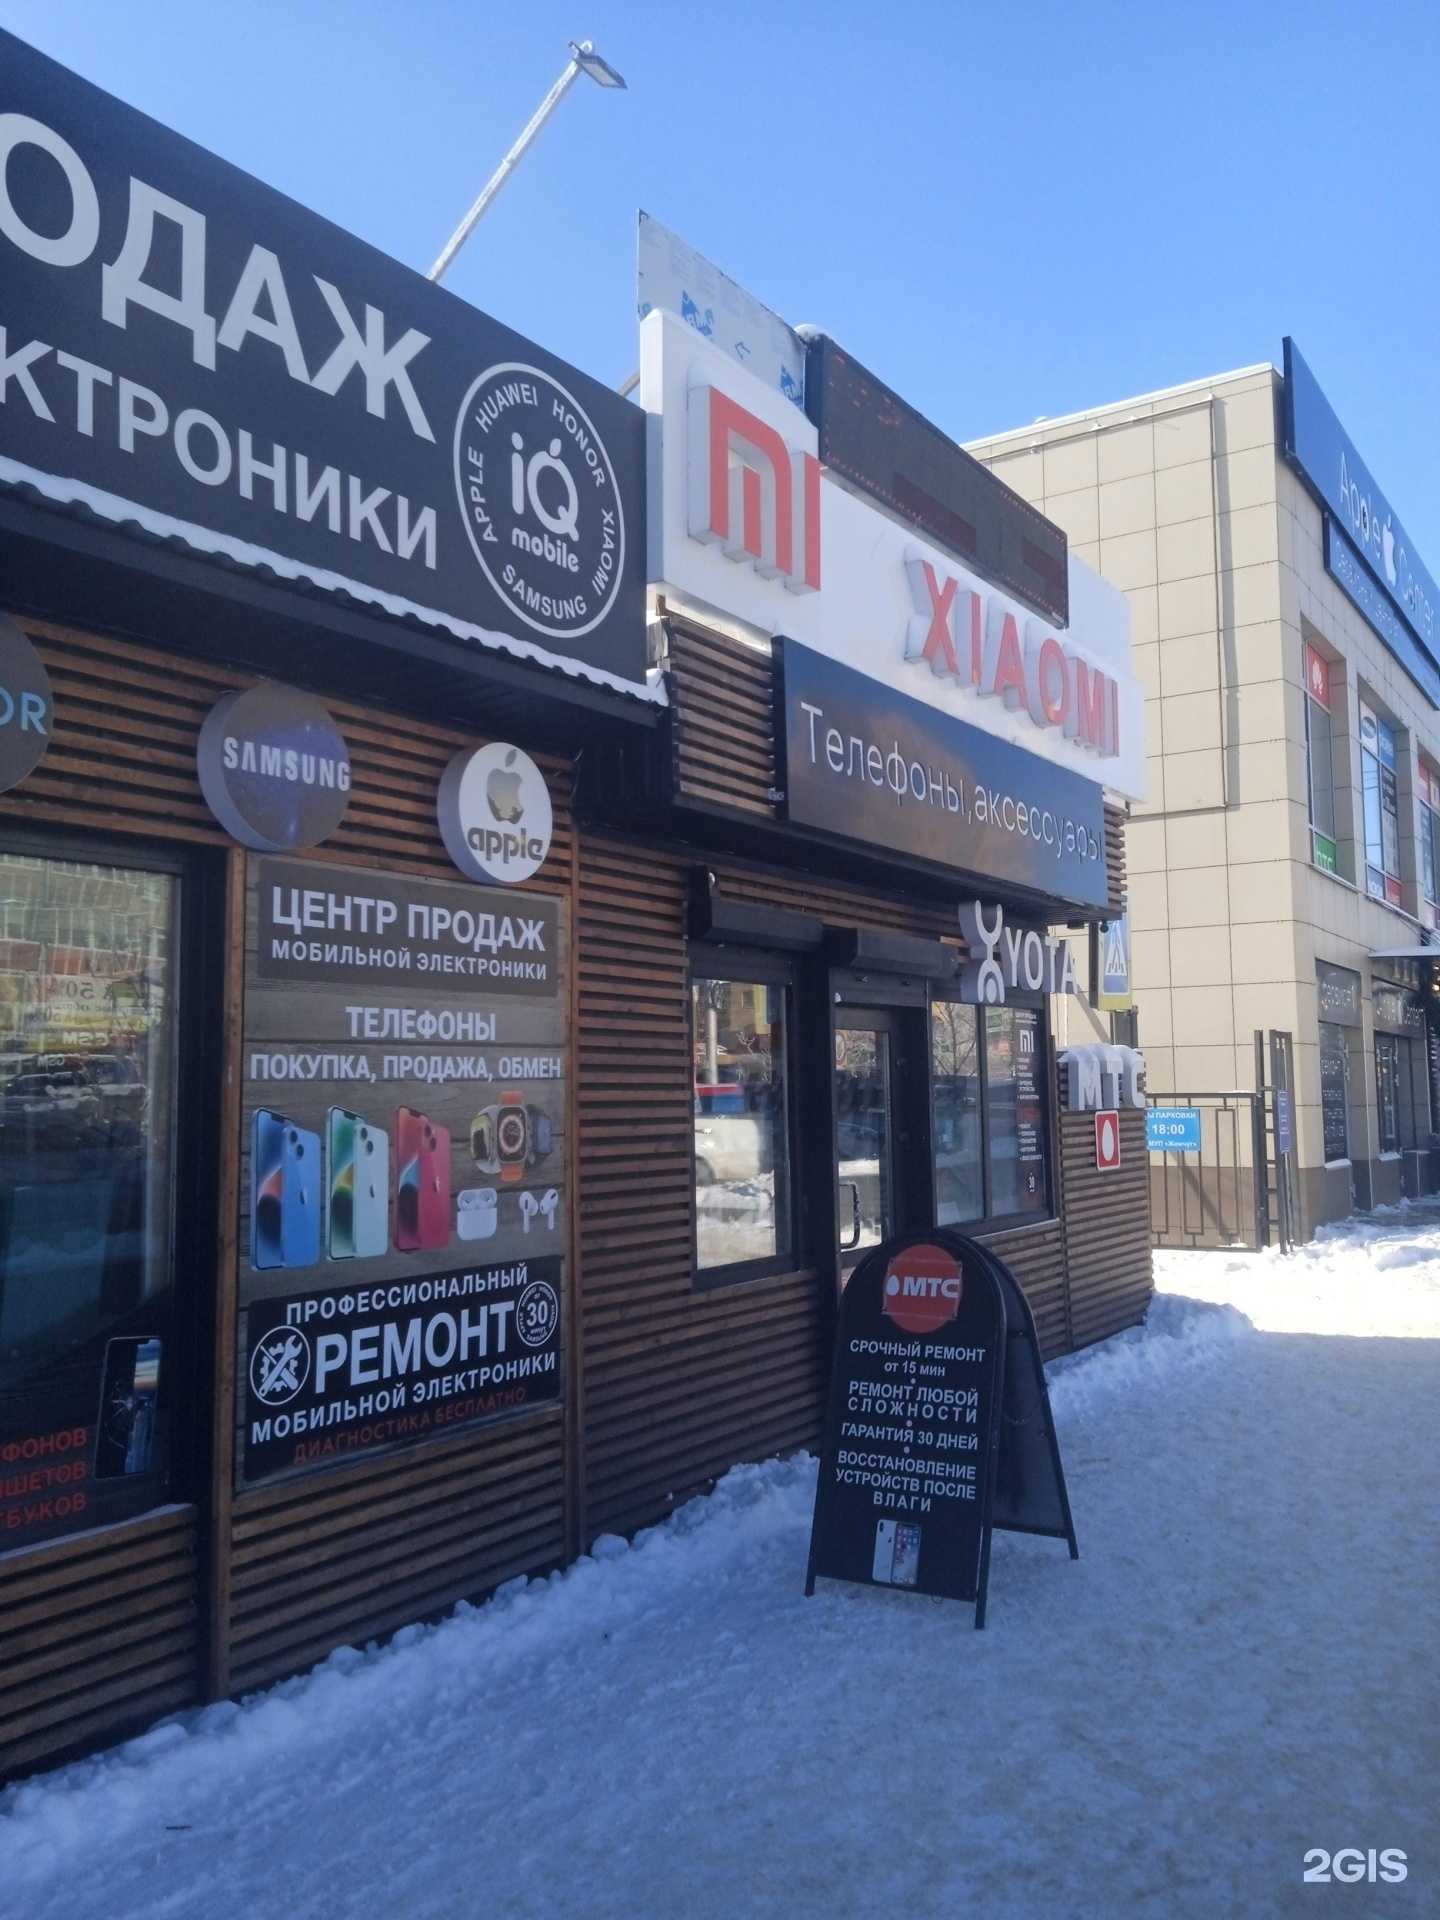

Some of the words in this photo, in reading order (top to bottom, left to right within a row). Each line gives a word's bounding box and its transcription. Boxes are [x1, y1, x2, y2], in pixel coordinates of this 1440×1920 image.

[0, 112, 437, 443] ОДАЖ
[0, 325, 437, 570] КТРОНИКИ
[475, 382, 539, 434] HUAWEI
[553, 398, 606, 487] HONOR
[468, 446, 498, 543] APPLE
[511, 431, 580, 541] iQ
[511, 527, 580, 573] mobile
[592, 508, 615, 595] XIAOMI
[502, 564, 587, 620] SAMSUNG
[918, 560, 1119, 757] XIAOMI
[223, 737, 351, 792] SAMSUNG
[466, 828, 544, 864] apple
[272, 886, 397, 935] ЦЕНТР
[408, 904, 546, 953] ПРОДАЖ
[271, 939, 411, 969] МОБИЛЬНОЙ
[416, 952, 547, 981] ЭЛЕКТРОНИКИ
[1004, 926, 1078, 994] YOTA
[346, 1006, 496, 1041] ТЕЛЕФОНЫ
[250, 1054, 377, 1083] ПОКУПКА,
[383, 1055, 494, 1084] ПРОДАЖА,
[499, 1057, 561, 1079] ОБМЕН
[1068, 1050, 1146, 1111] МТС
[1152, 1124, 1185, 1135] 18:00
[286, 1261, 528, 1326] ПРОФЕССИОНАЛЬНЫЙ
[902, 1276, 960, 1298] МТС
[526, 1300, 548, 1327] 30
[315, 1301, 515, 1394] РЕМОНТ
[850, 1339, 921, 1358] СРОЧНЫЙ
[924, 1345, 986, 1362] РЕМОНТ
[884, 1362, 898, 1373] от
[902, 1361, 916, 1374] 15
[919, 1366, 946, 1377] мин
[252, 1383, 405, 1444] МОБИЛЬНОЙ
[412, 1352, 556, 1403] ЭЛЕКТРОНИКИ
[848, 1381, 913, 1400] РЕМОНТ
[916, 1387, 979, 1407] ЛЮБОЙ
[848, 1397, 978, 1424] СЛОЖНОСТИ
[294, 1413, 432, 1465] ДИАГНОСТИКА
[434, 1386, 526, 1424] БЕСПЛАТНО
[841, 1422, 914, 1443] ГАРАНТИЯ
[917, 1431, 934, 1445] 30
[936, 1433, 979, 1451] ДНЕЙ
[0, 1460, 88, 1498] ШЕТОВ
[835, 1468, 920, 1492] УСТРОЙСТВ
[924, 1480, 976, 1500] ПОСЛЕ
[837, 1450, 977, 1480] ВОССТАНОВЛЕНИЕ
[873, 1491, 931, 1512] ВЛАГИ
